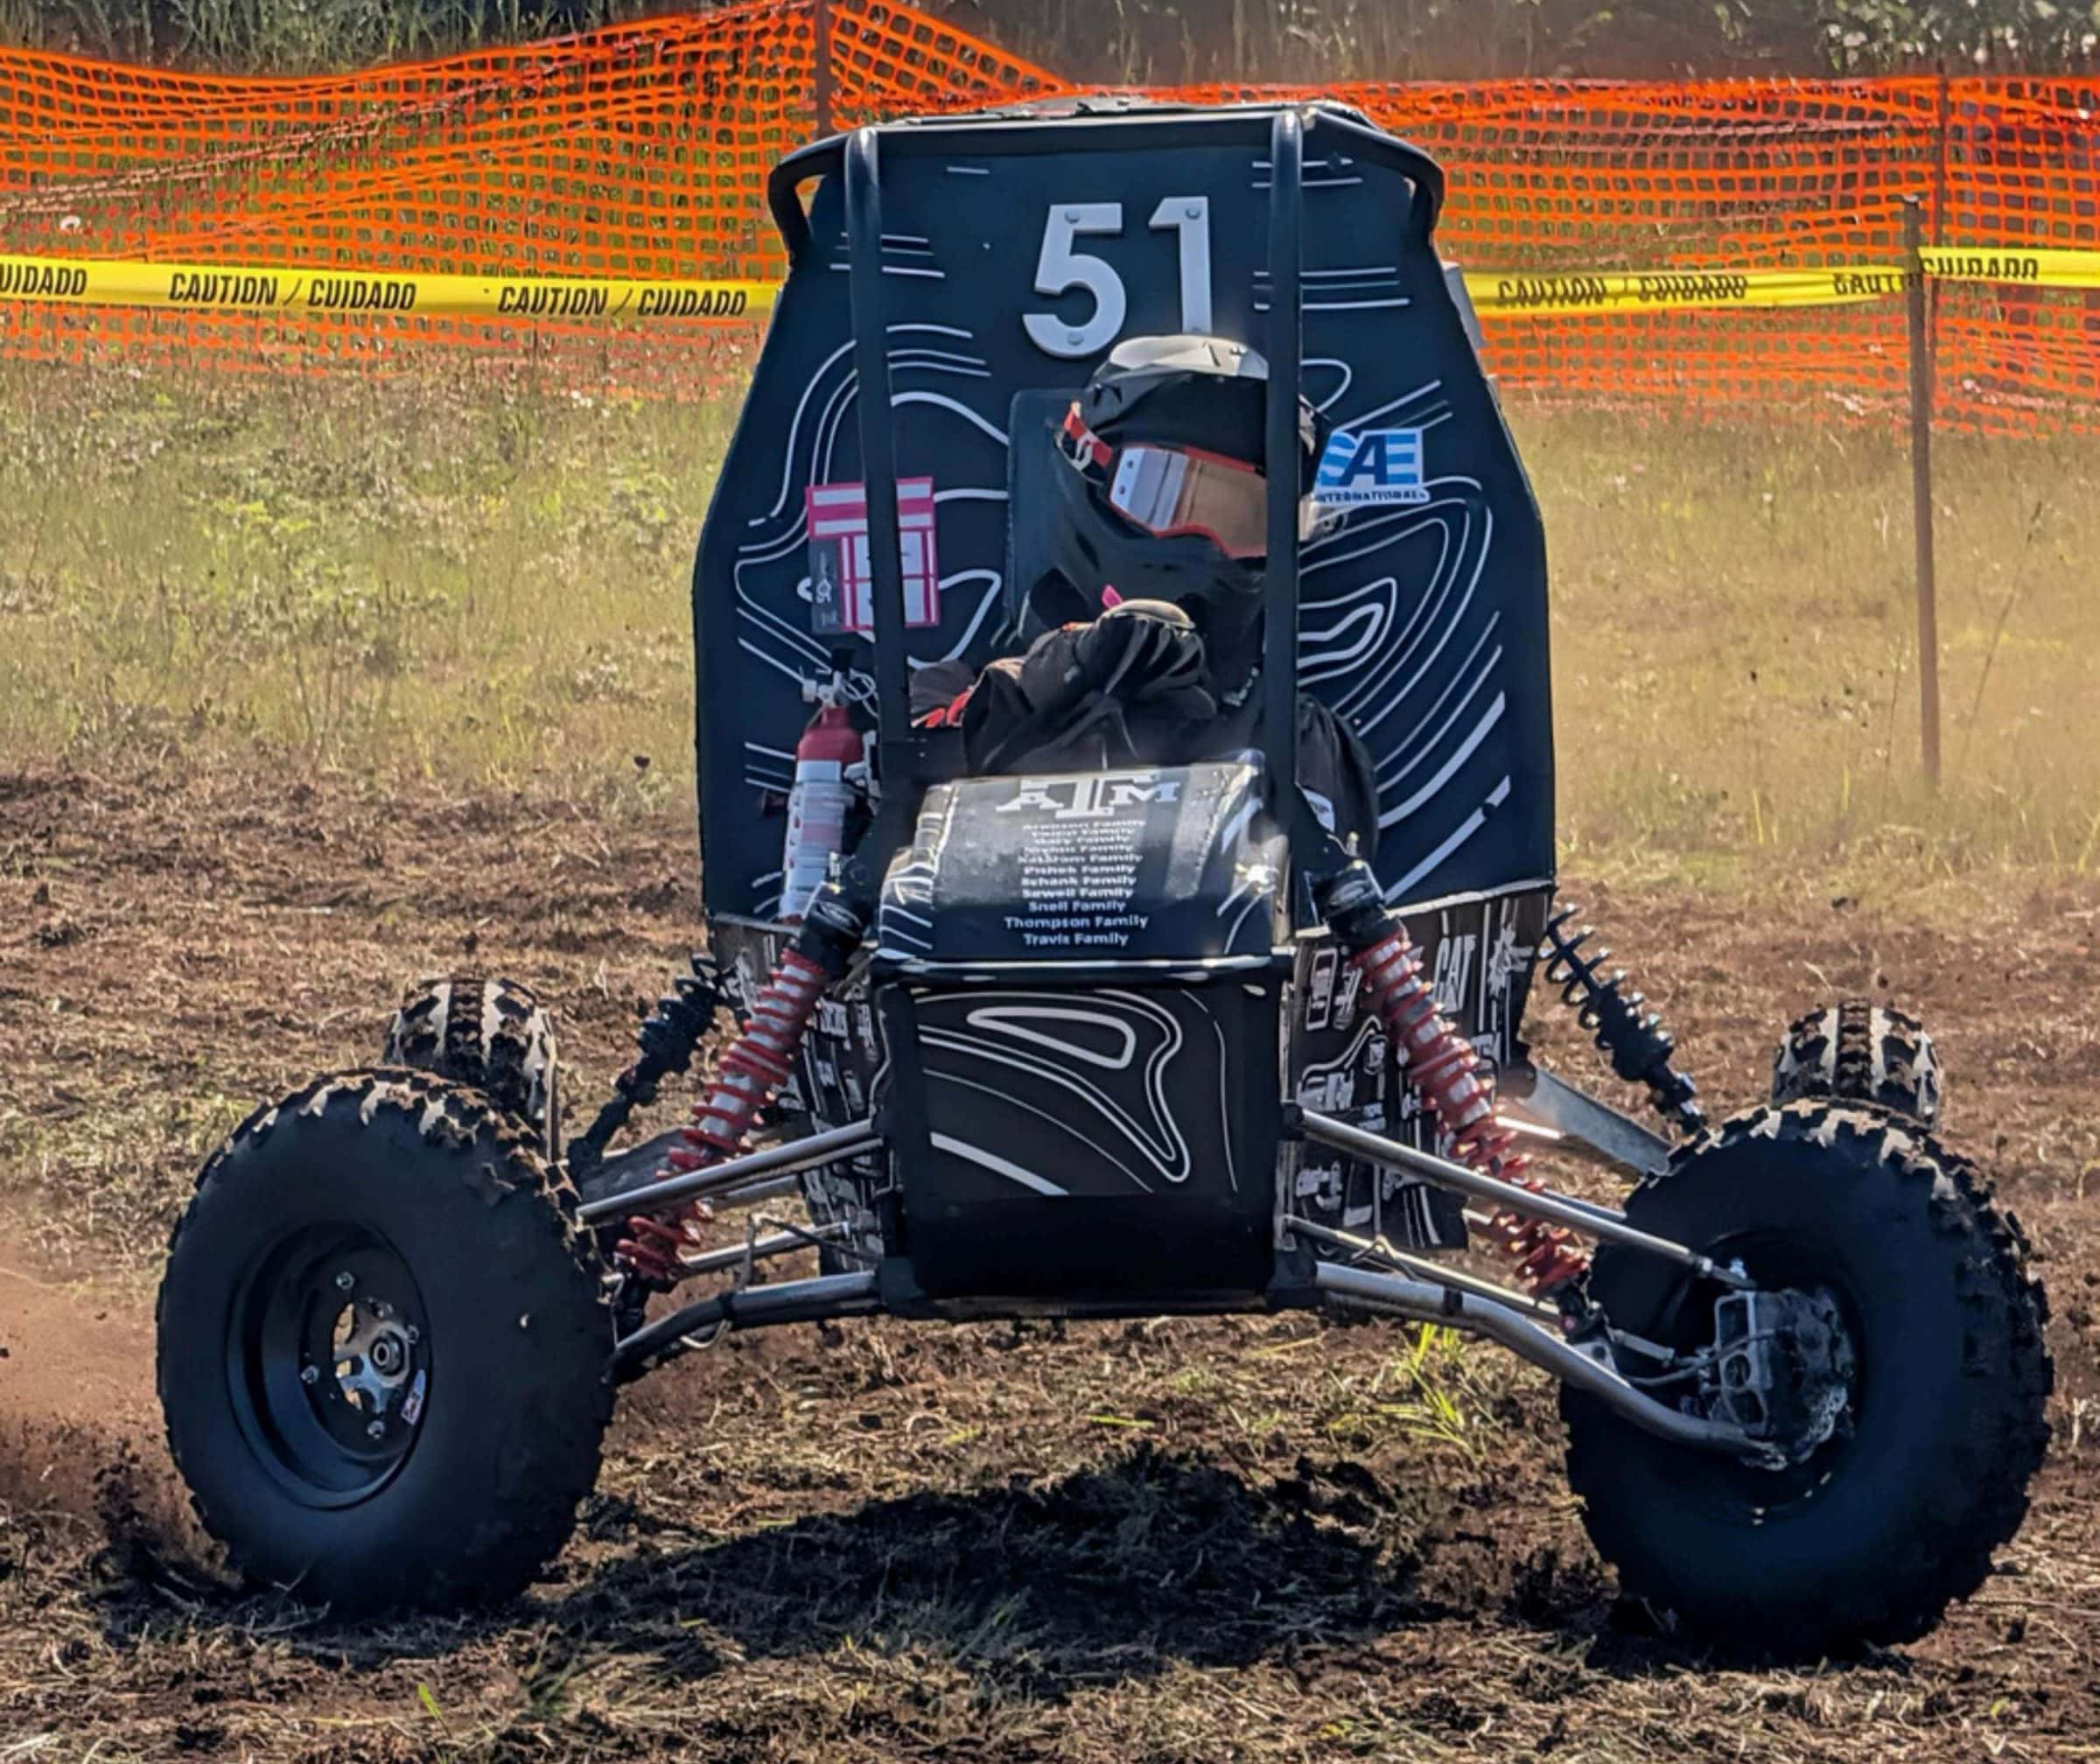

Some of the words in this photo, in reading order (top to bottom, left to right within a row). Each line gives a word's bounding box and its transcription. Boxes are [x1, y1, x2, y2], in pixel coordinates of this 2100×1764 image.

[0, 263, 88, 296] UIDADO
[1022, 195, 1213, 360] 51
[169, 272, 278, 306] CAUTION
[307, 278, 416, 312] CUIDADO
[1497, 276, 1606, 307] CAUTION
[1637, 274, 1748, 302] CUIDADO
[498, 285, 608, 316] CAUTION
[637, 288, 747, 317] CUIDADO
[1315, 429, 1423, 486] SAE
[1088, 852, 1144, 864] Family
[1081, 862, 1135, 875] Family
[1082, 875, 1137, 886] Family
[1079, 887, 1133, 899] Family
[1029, 900, 1068, 912] Snell
[1072, 900, 1126, 913] Family
[1004, 916, 1090, 929] Thompson
[1096, 914, 1149, 929] Family
[1023, 932, 1070, 946] Travis
[1074, 932, 1129, 947] Family
